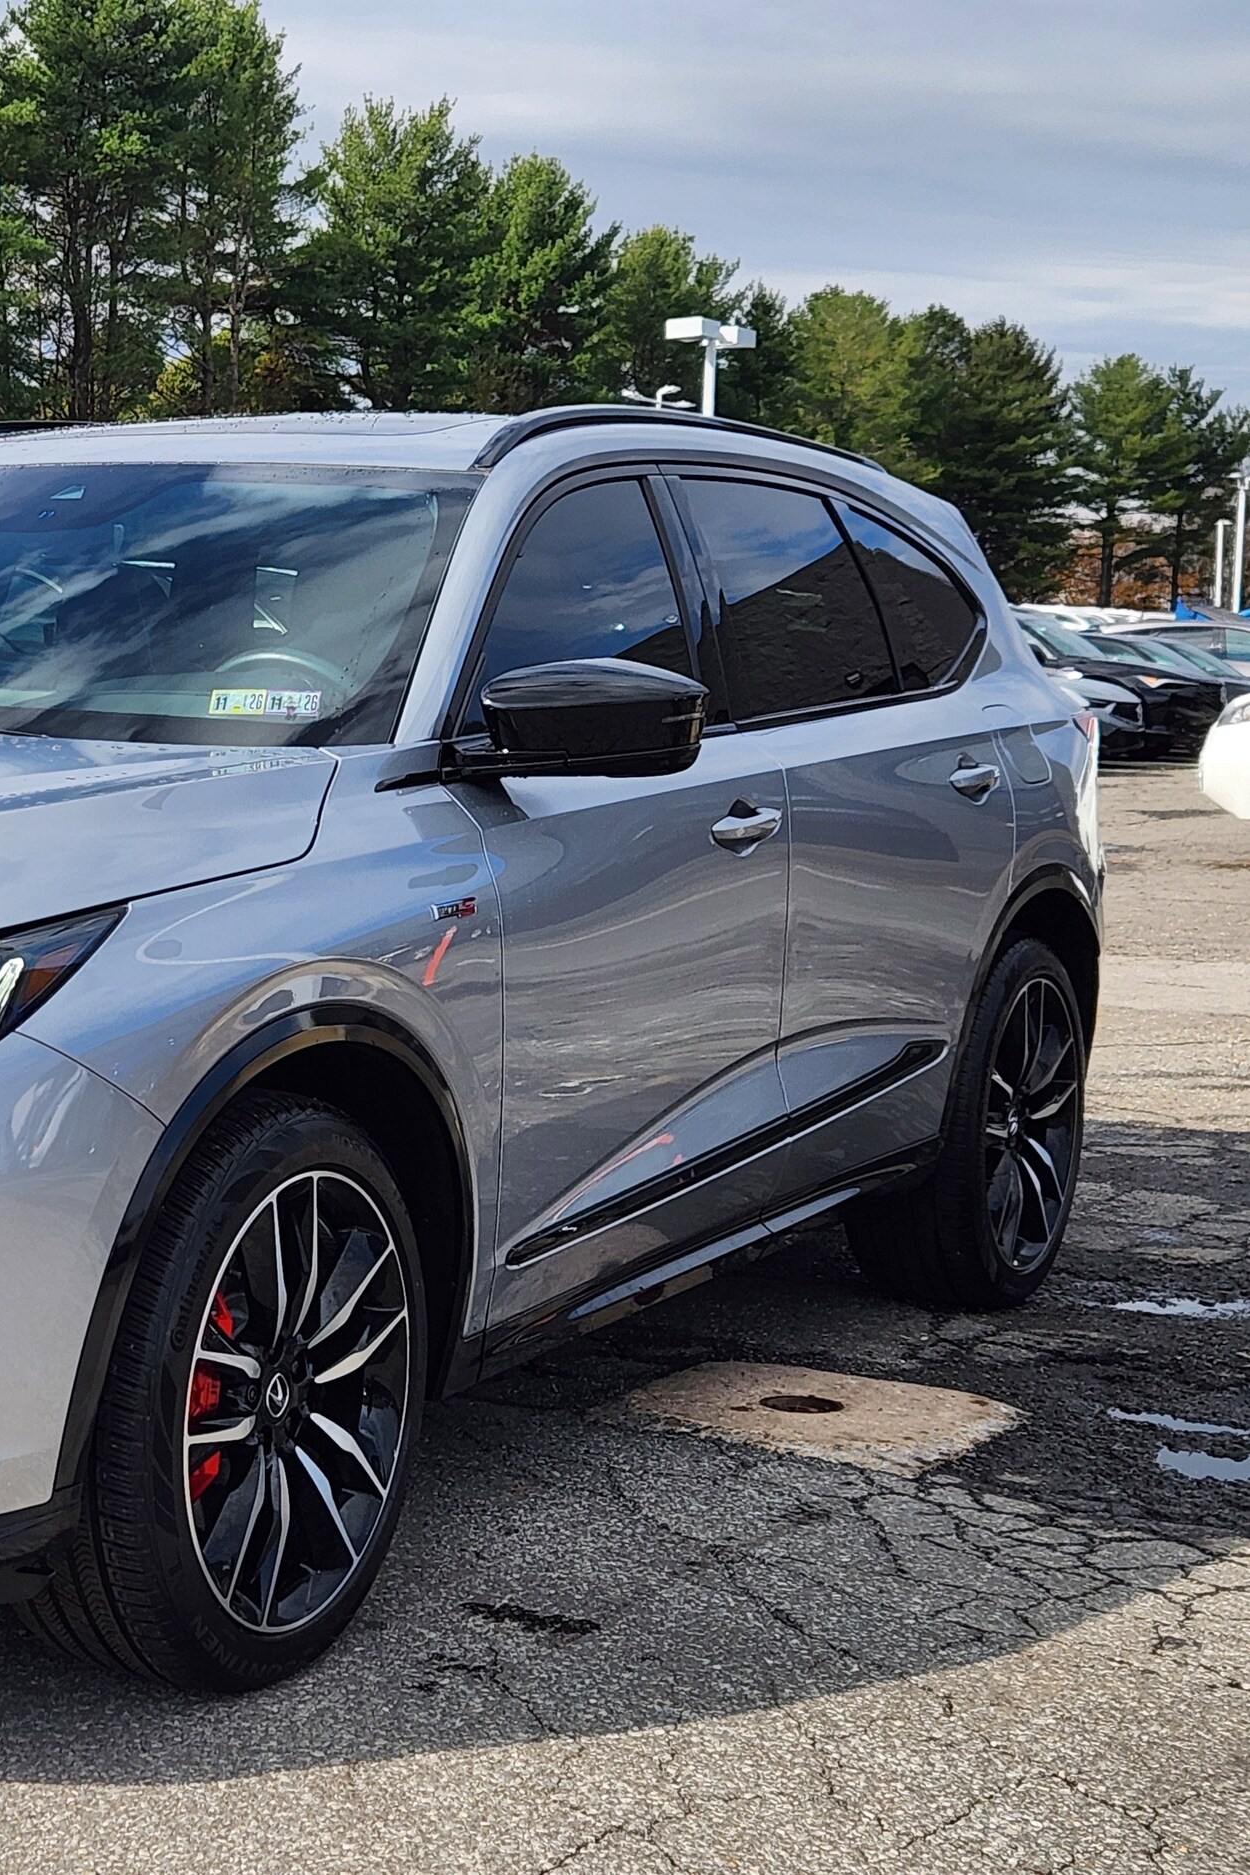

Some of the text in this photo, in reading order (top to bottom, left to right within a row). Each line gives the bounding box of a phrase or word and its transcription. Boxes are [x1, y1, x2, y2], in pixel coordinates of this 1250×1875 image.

[214, 693, 263, 710] 11 26
[304, 694, 318, 711] 26
[169, 1230, 219, 1353] Continental
